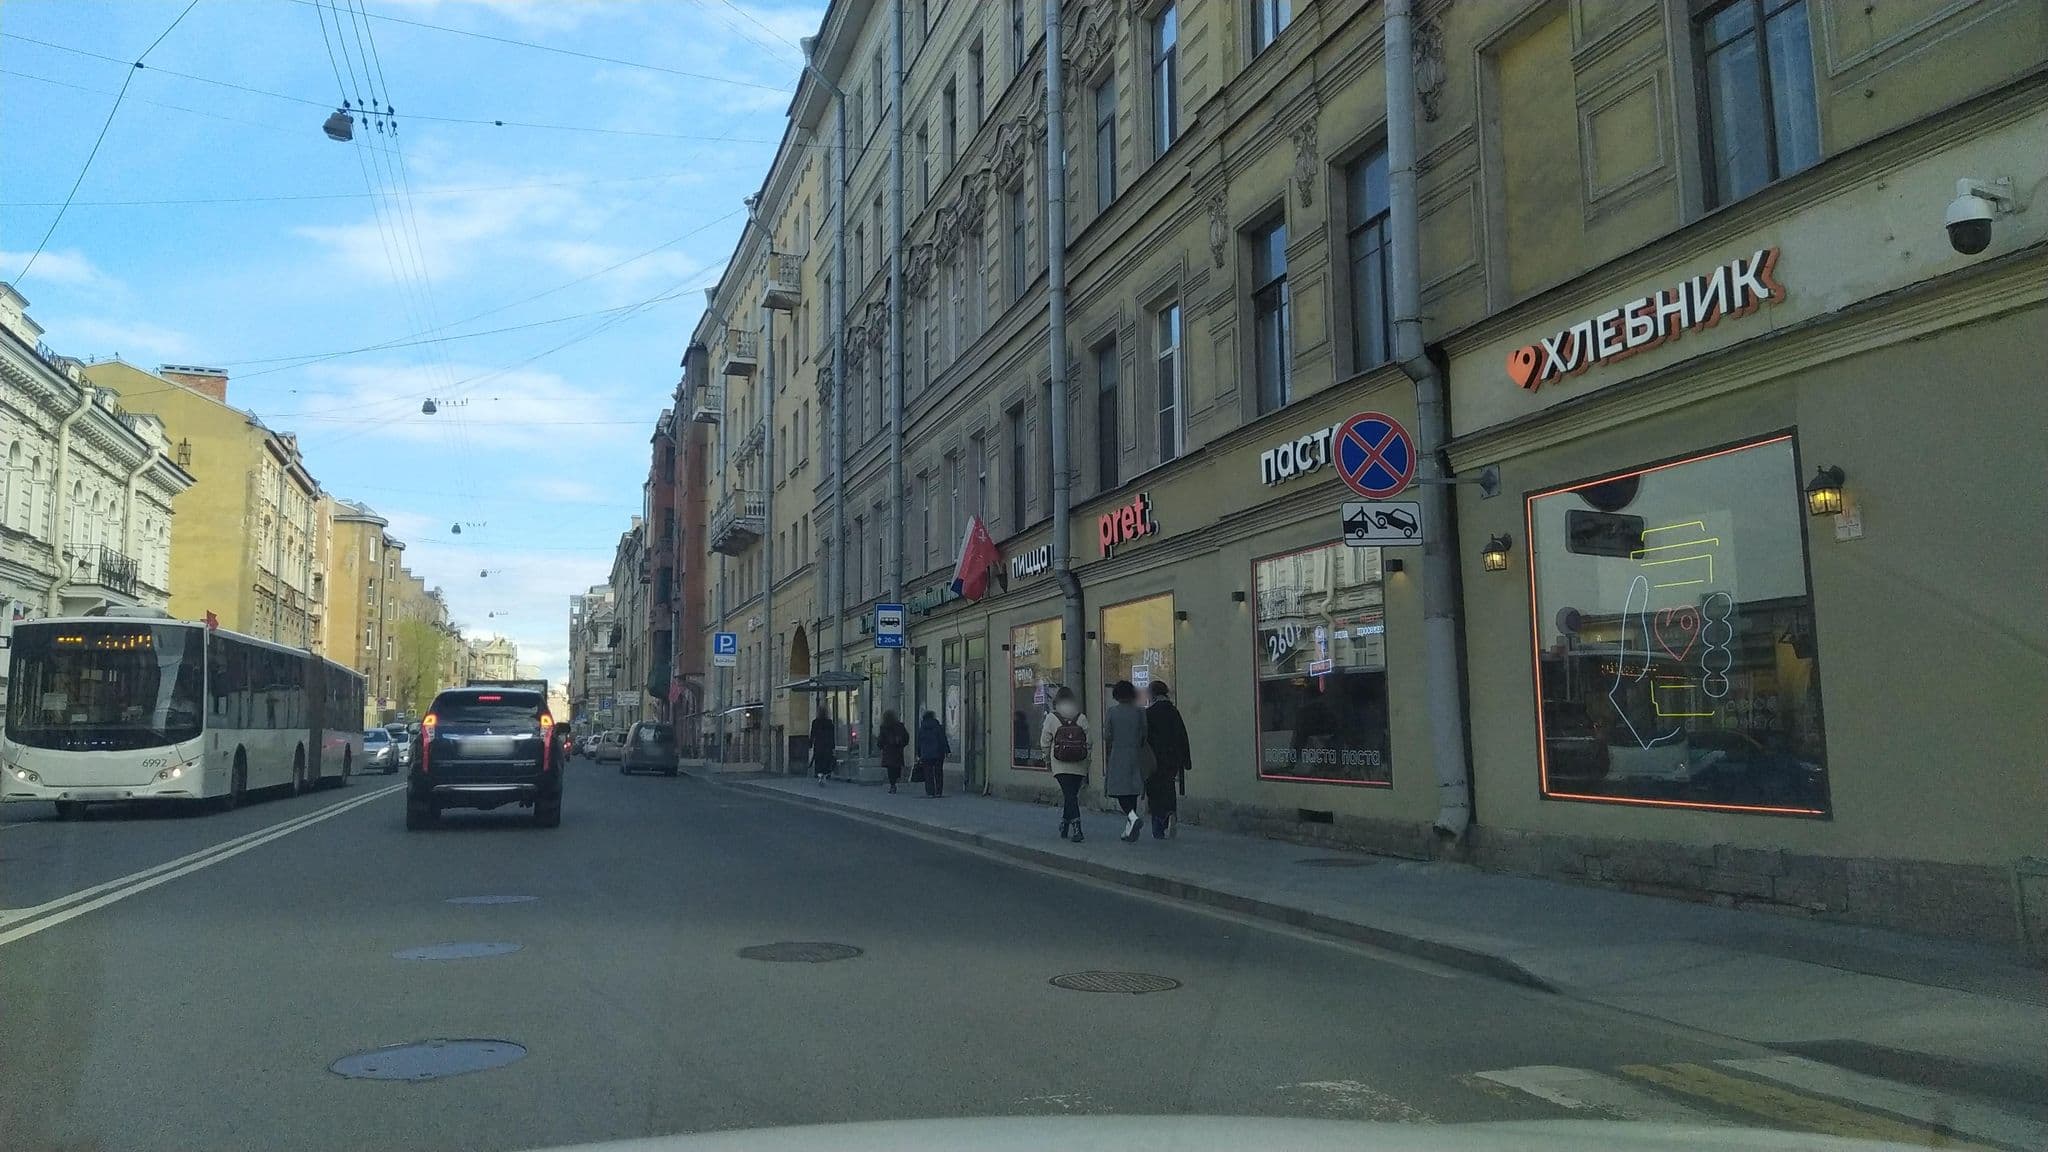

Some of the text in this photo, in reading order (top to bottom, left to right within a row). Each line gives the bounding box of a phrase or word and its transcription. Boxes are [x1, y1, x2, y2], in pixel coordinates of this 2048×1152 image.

[1539, 248, 1770, 380] ХЛЕБНИК
[142, 758, 168, 768] 6992
[1340, 749, 1381, 767] паста
